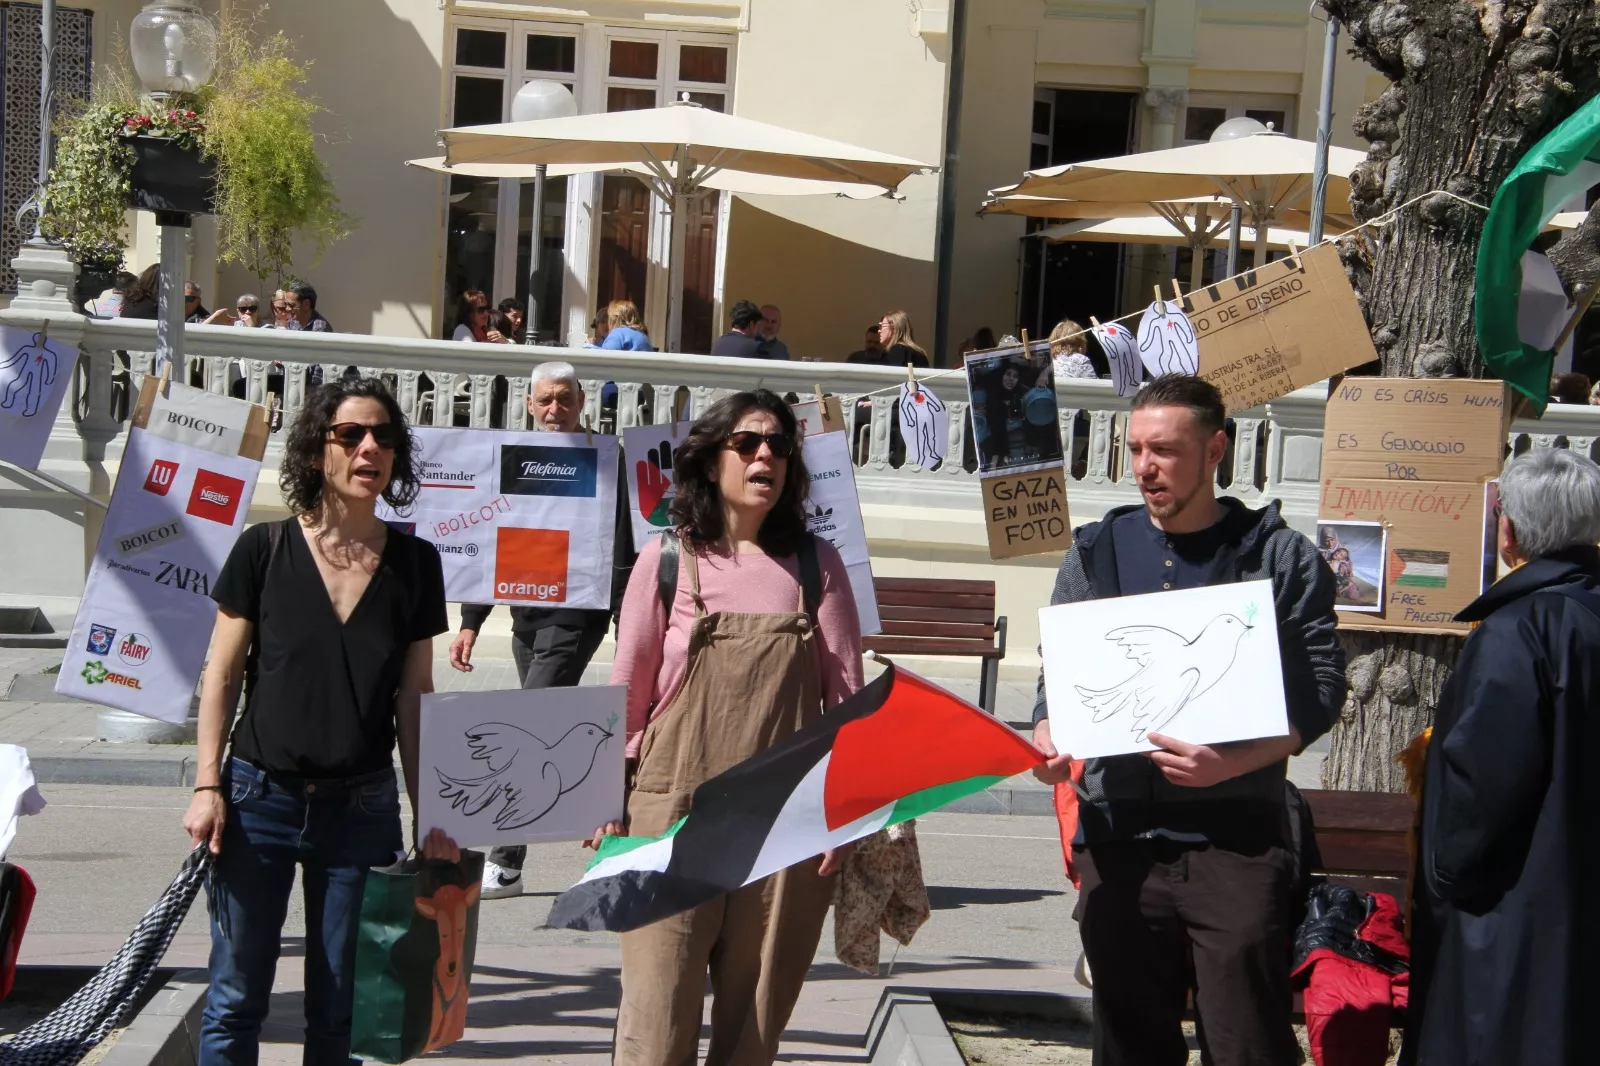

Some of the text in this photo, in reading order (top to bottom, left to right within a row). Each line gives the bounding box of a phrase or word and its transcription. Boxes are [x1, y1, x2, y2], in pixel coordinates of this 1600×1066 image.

[1217, 305, 1240, 323] DE
[1246, 279, 1303, 311] DISEÑO
[1235, 382, 1246, 392] DE
[1248, 378, 1258, 387] LA
[1260, 365, 1288, 380] RIBERA
[1339, 385, 1363, 402] NO
[1374, 388, 1394, 402] ES
[1404, 386, 1449, 404] CRISIS
[167, 411, 228, 438] BOICOT
[1337, 433, 1358, 449] ES
[151, 463, 172, 487] LU
[419, 469, 476, 481] Santander
[809, 469, 842, 482] EMENS
[1385, 462, 1420, 480] POR
[992, 476, 1063, 501] GAZA
[992, 498, 1061, 522] EN UNA
[120, 522, 179, 552] BOICOT
[1005, 516, 1065, 545] FOTO
[154, 560, 209, 596] ZARA
[497, 581, 559, 599] orange
[1390, 591, 1427, 606] FREE
[1404, 607, 1470, 625] PALESTI
[120, 640, 150, 661] FAIRY
[104, 672, 142, 690] ARIEL
